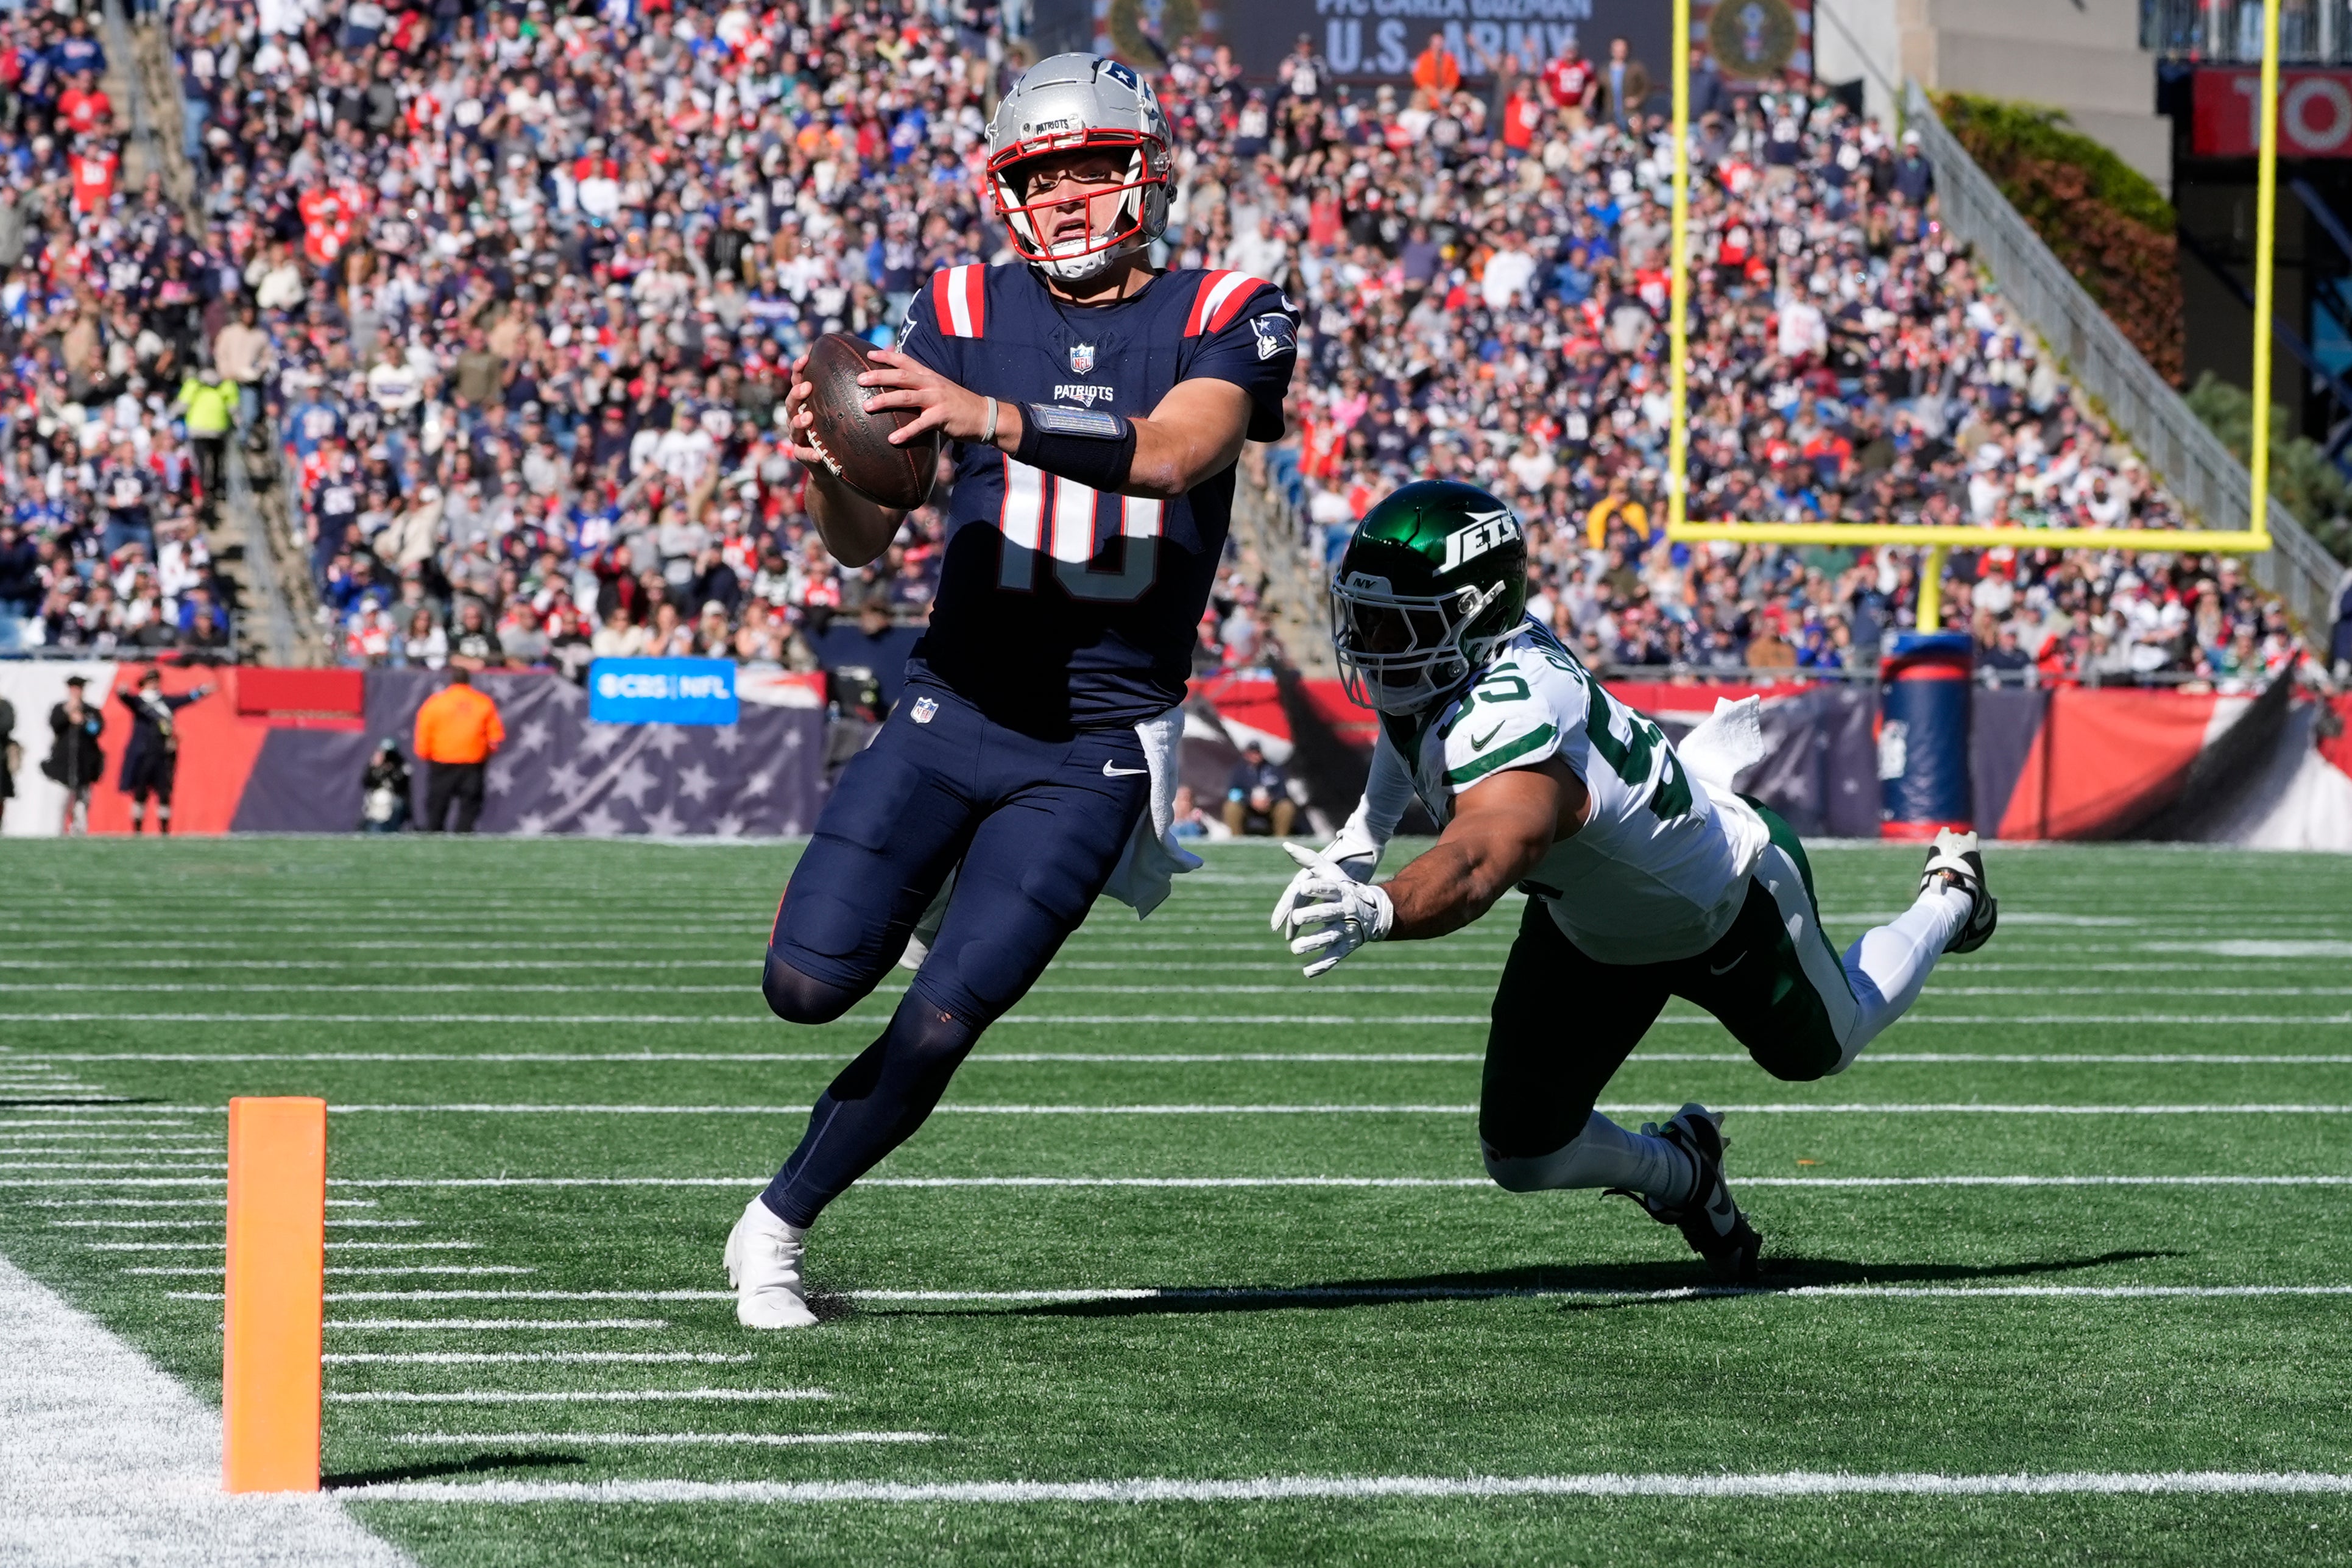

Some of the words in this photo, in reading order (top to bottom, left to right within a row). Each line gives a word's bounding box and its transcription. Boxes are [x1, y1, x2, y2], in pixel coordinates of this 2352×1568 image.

[1326, 18, 1421, 74] U.S.
[1443, 20, 1577, 76] ARMY
[1036, 119, 1069, 135] PATRIOTS
[1075, 358, 1090, 369] NFL
[1053, 384, 1114, 402] PATRIOTS
[995, 452, 1165, 604] 10
[1433, 510, 1517, 578] JETS
[1353, 577, 1377, 589] NY
[618, 674, 668, 699] CBS
[679, 674, 730, 699] NFL
[915, 707, 930, 719] NFL
